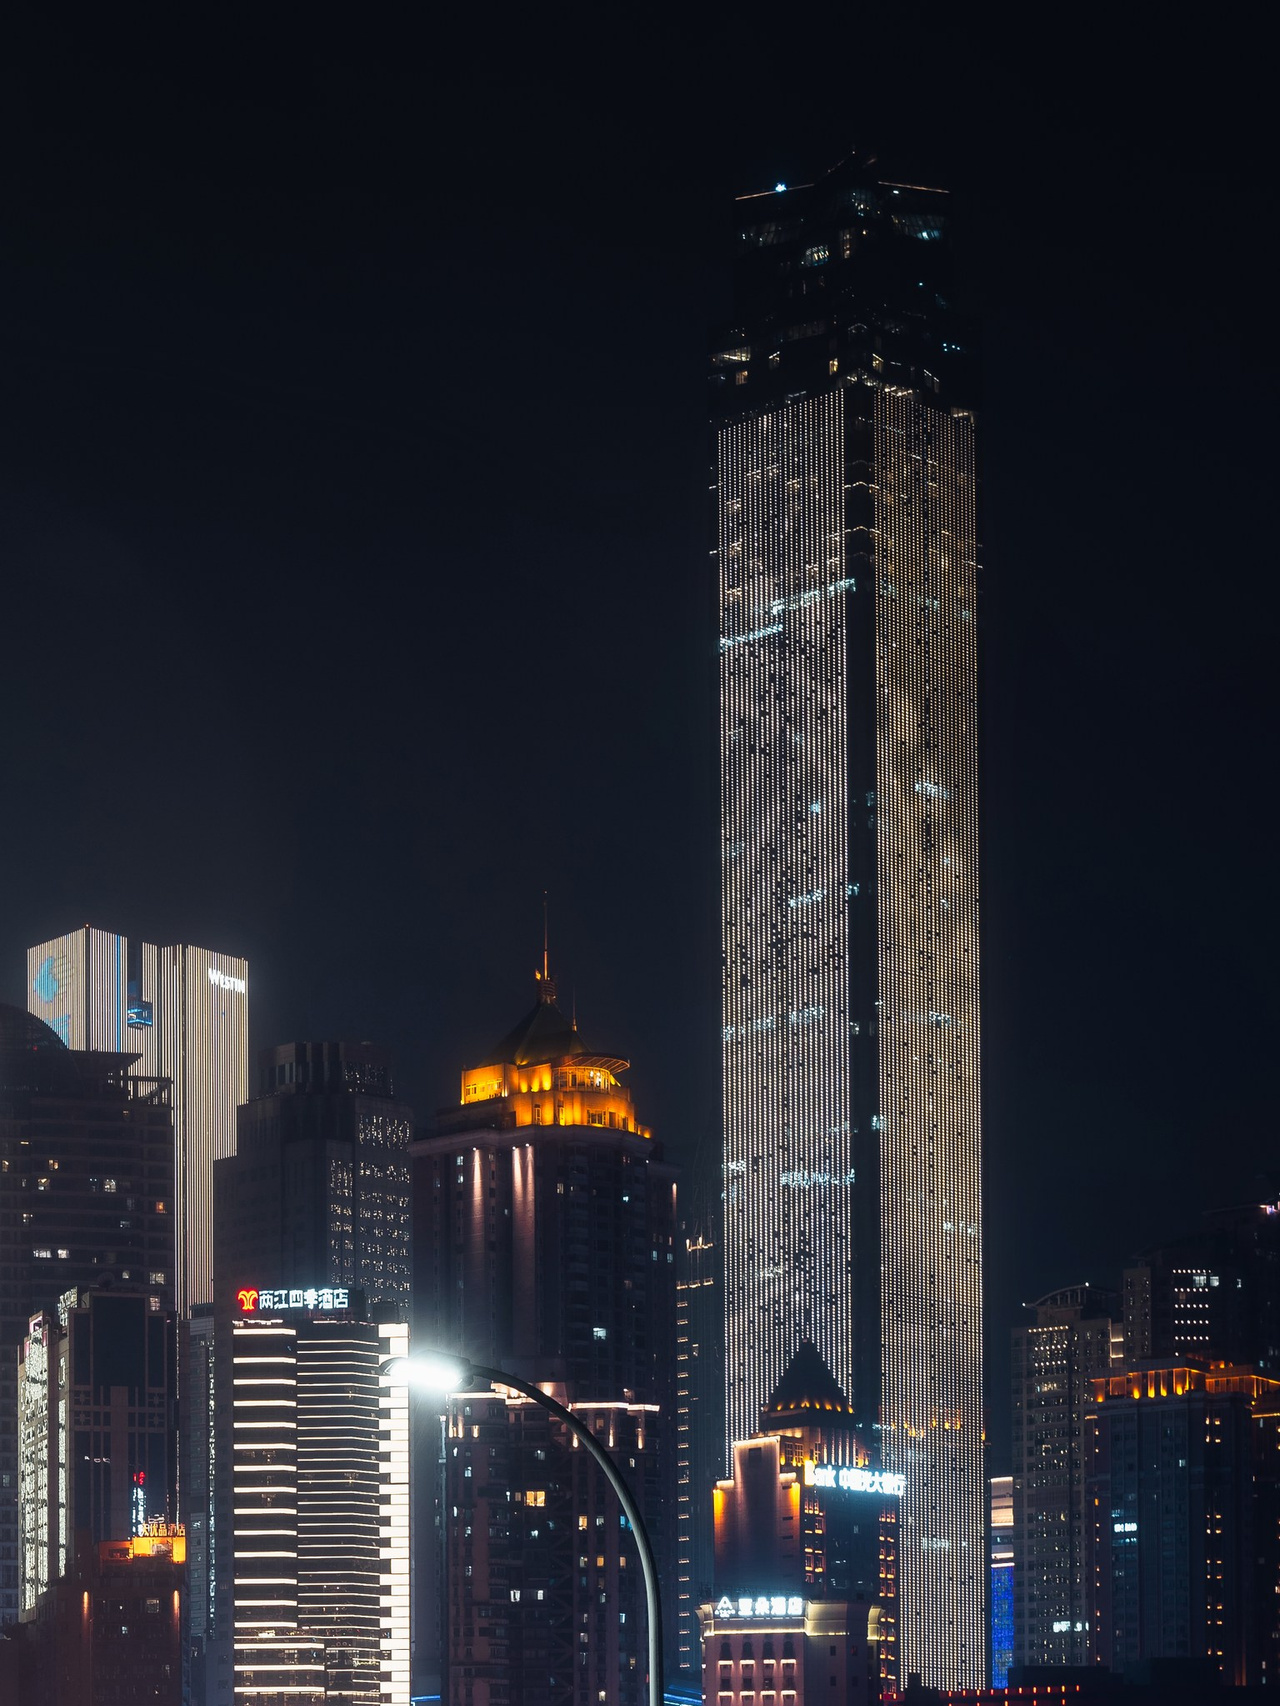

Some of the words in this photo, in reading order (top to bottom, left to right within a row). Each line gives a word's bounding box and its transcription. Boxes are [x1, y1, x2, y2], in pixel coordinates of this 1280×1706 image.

[258, 1288, 349, 1310] 两江四季酒店
[804, 1459, 837, 1488] Bank
